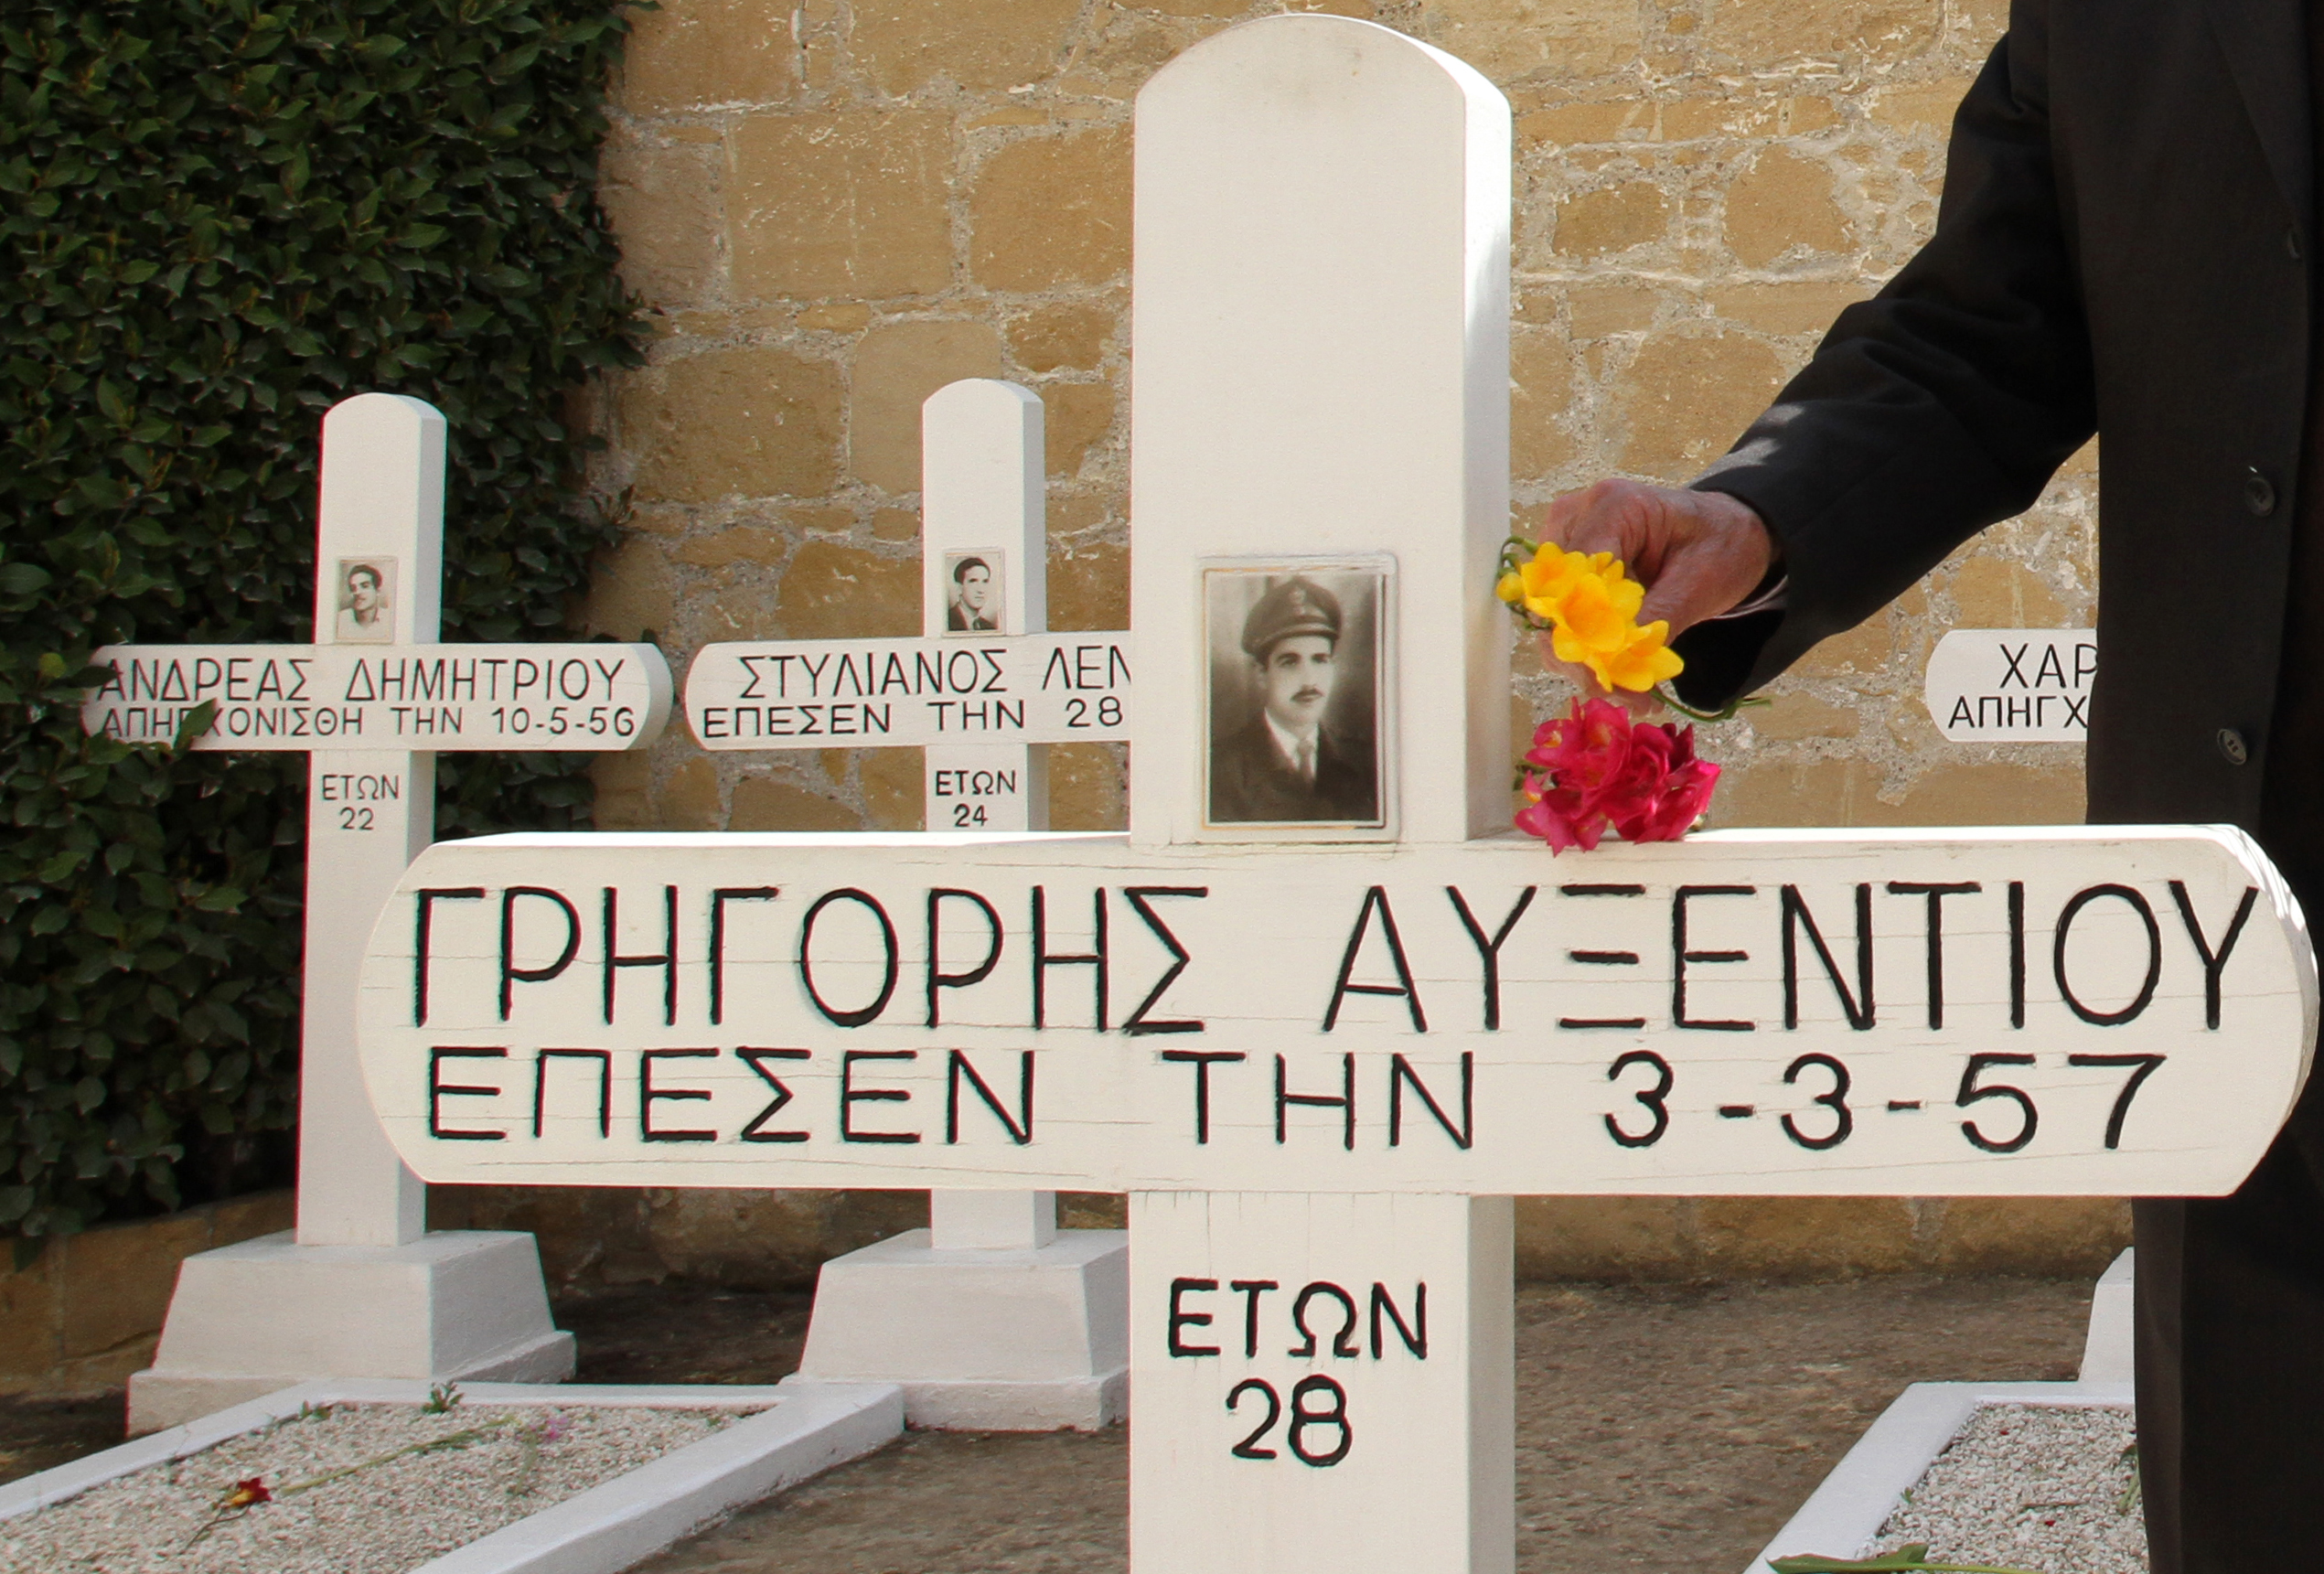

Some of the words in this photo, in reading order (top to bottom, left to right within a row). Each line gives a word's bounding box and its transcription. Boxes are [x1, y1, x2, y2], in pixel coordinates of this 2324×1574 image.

[97, 657, 314, 701] ΑΝΔΡΕΑΣ
[345, 658, 626, 701] ΔΗΜΗΤΡΙΟΥ
[739, 648, 1008, 699] ΣΤΥΛΙΑΝΟΣ
[1999, 643, 2098, 689] ΧΑΡ
[391, 706, 463, 735] ΤΗΝ
[491, 706, 636, 737] 10-5-56
[703, 702, 892, 738] ΕΠΕΣΕΝ
[926, 699, 1025, 732] ΤΗΝ
[322, 773, 401, 801] ΕΤΩΝ
[935, 769, 1016, 797] ΕΤΩΝ
[339, 806, 375, 830] 22
[953, 803, 989, 828] 24
[413, 884, 1209, 1035] ΓΡΗΓΟΡΗΣ
[1323, 880, 2259, 1033] ΑΥΞΕΝΤΙΟΥ
[429, 1046, 1035, 1145] ΕΠΕΣΕΝ
[1161, 1050, 1474, 1151] ΤΗΝ
[1603, 1049, 2168, 1154] 3-3-57
[1167, 1277, 1429, 1360] ΕΤΩΝ
[1225, 1374, 1354, 1469] 28
